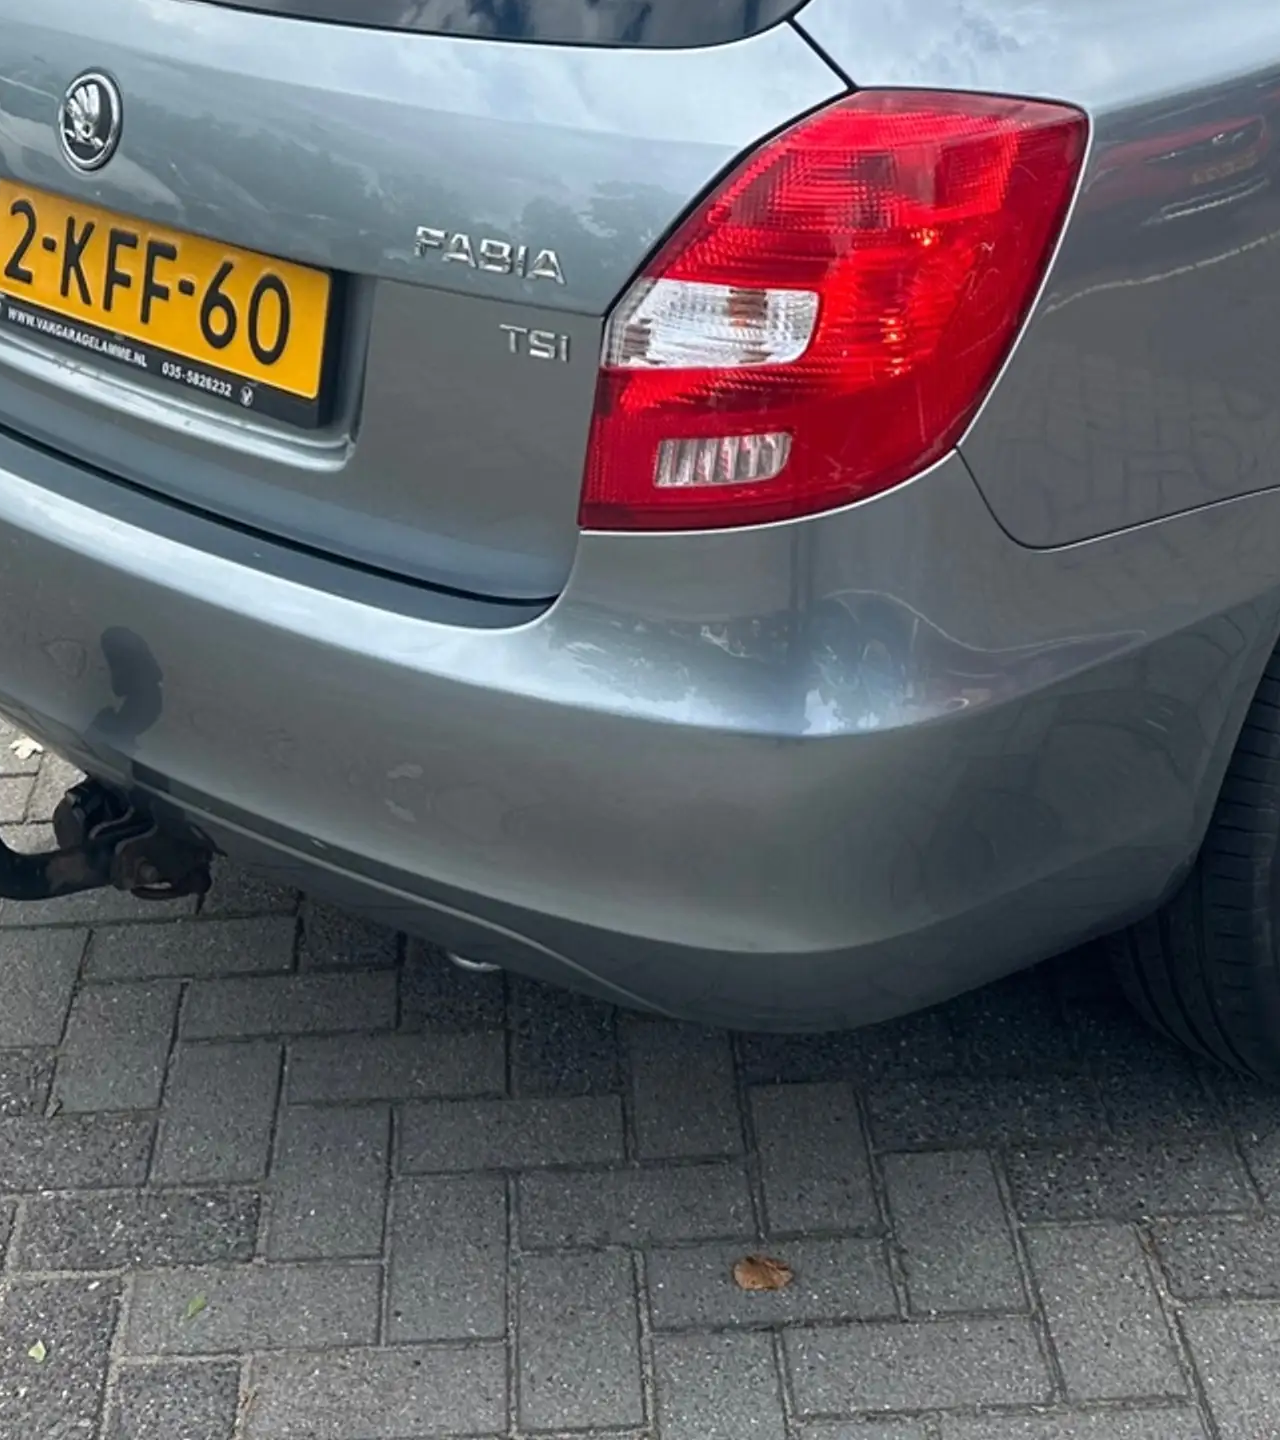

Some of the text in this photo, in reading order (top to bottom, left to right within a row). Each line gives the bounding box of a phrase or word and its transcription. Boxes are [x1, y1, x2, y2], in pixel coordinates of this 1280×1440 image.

[3, 198, 292, 367] 2-KFF-60
[413, 225, 567, 286] FABIA
[7, 306, 149, 368] WWW.VAKGARAGELAMME.NL
[161, 361, 233, 398] 035-5826232
[498, 323, 570, 364] TSI
